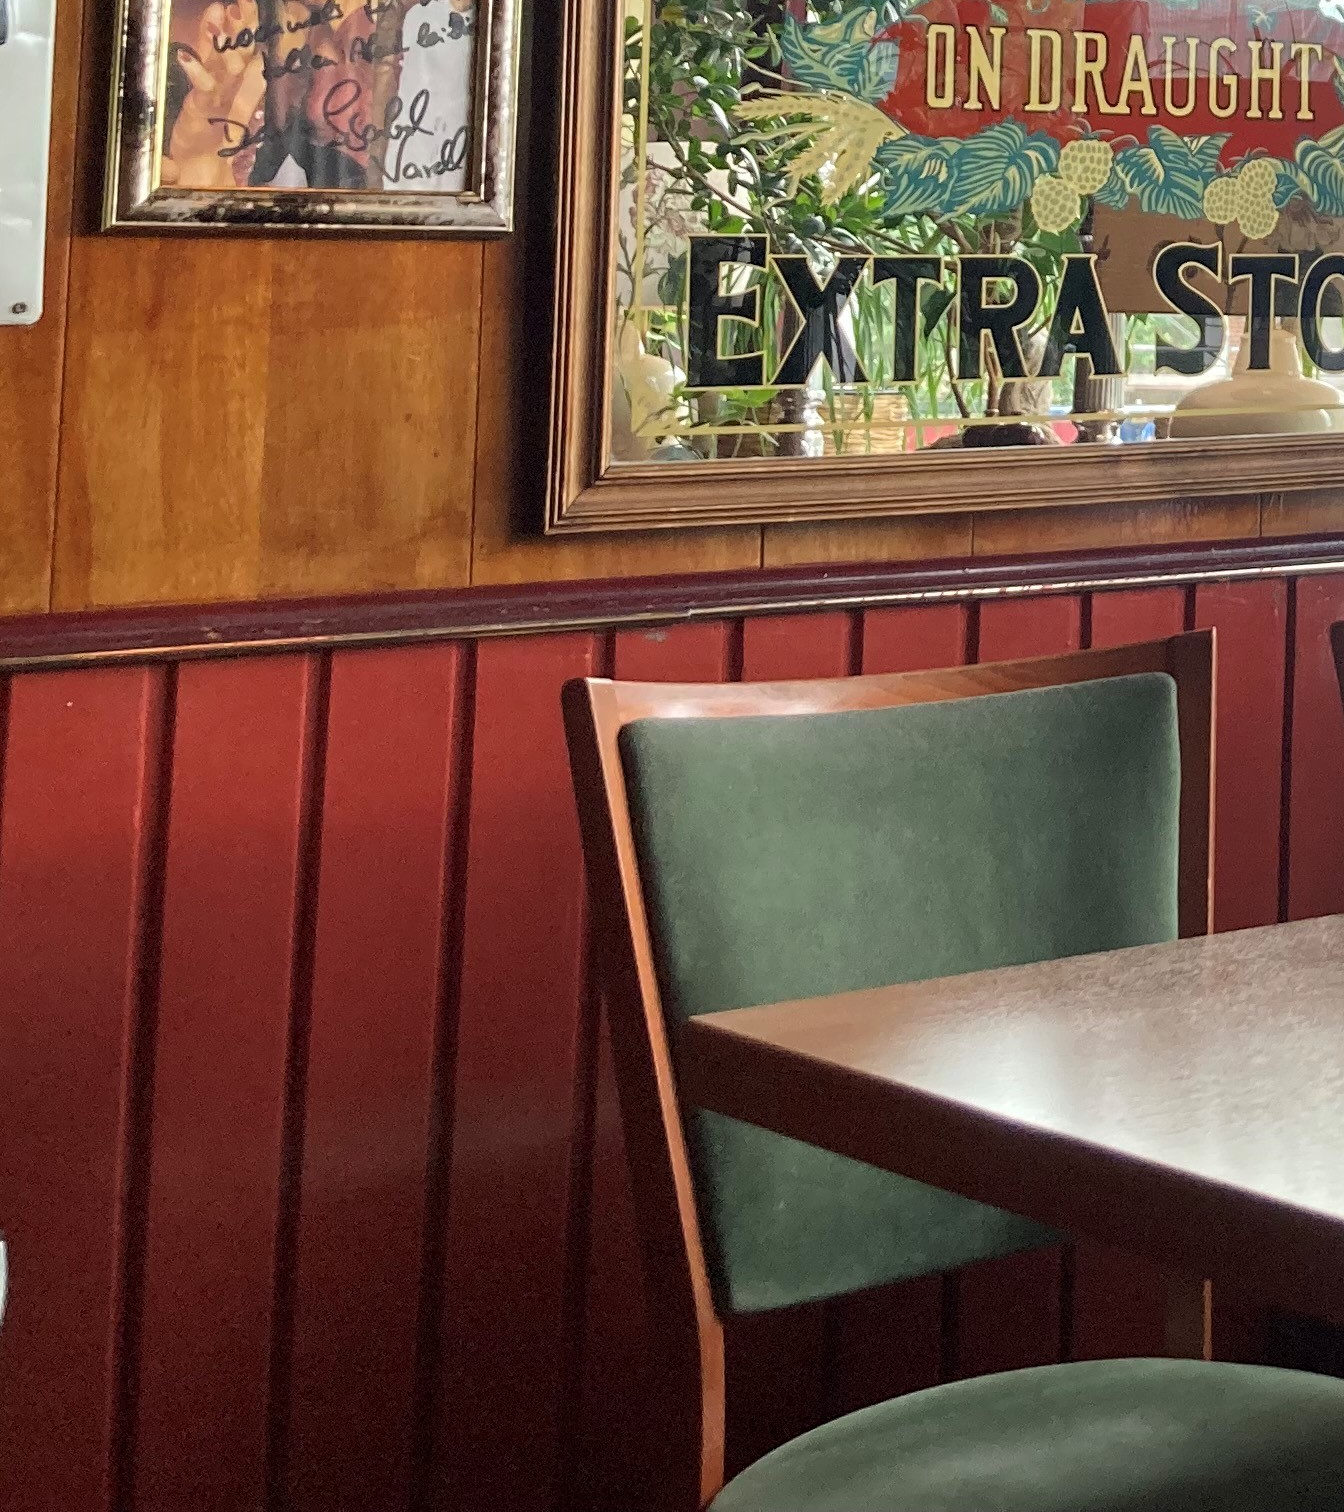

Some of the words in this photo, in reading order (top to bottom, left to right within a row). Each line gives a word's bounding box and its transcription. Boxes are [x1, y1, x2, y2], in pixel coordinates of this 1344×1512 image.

[925, 22, 1008, 113] ON
[1023, 27, 1323, 123] DRAUGHT
[684, 232, 1124, 392] EXTRA
